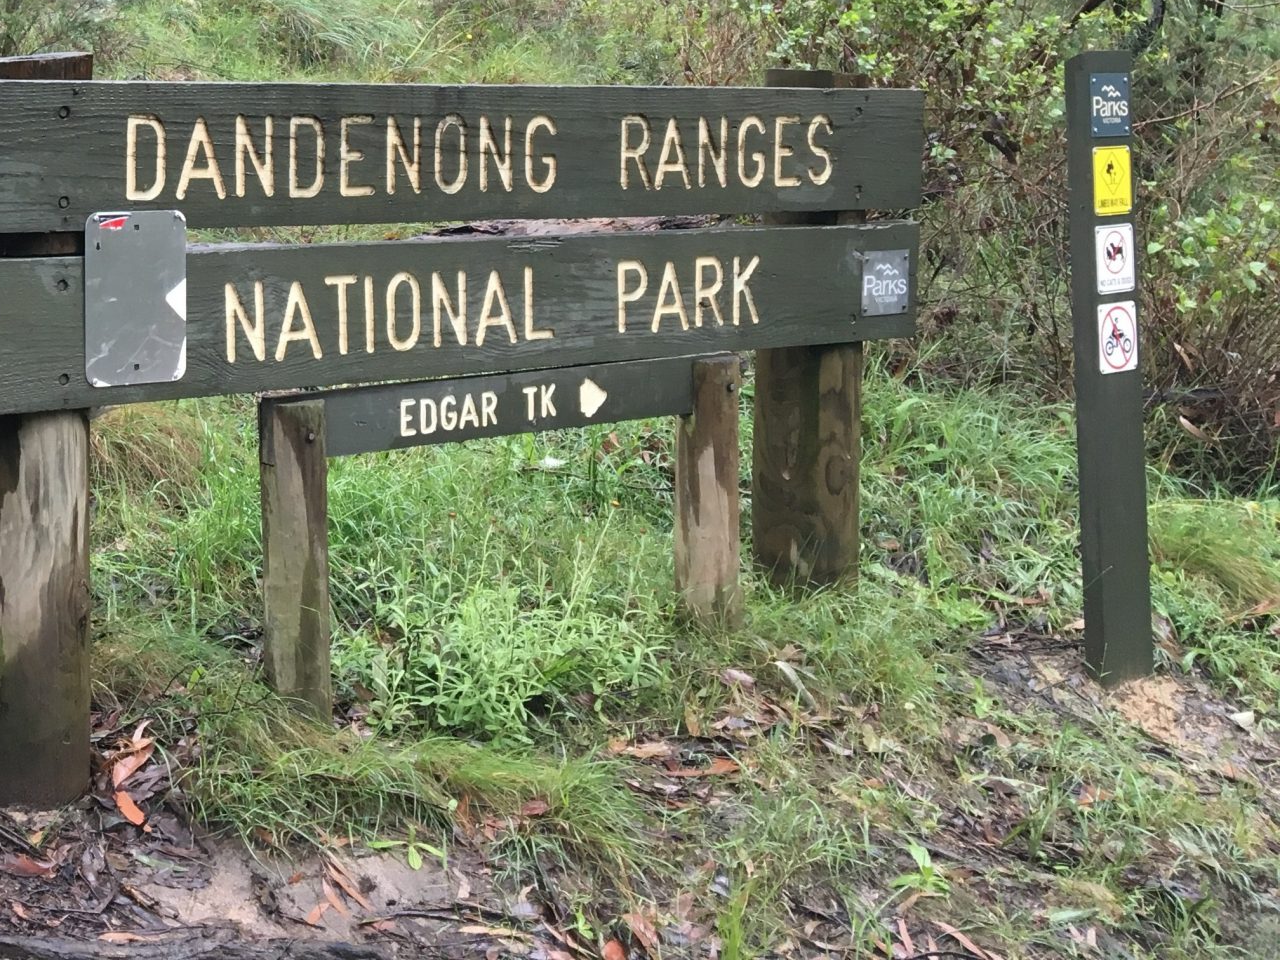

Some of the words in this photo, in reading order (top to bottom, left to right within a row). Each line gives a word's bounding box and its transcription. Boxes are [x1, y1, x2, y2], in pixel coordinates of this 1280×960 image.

[1092, 96, 1129, 117] Parks
[125, 113, 557, 201] DANDENONG
[620, 112, 834, 191] RANGES
[224, 266, 555, 364] NATIONAL
[618, 255, 760, 334] PARK
[863, 275, 908, 297] Parks
[401, 391, 498, 437] EDGAR
[521, 384, 557, 422] TK
